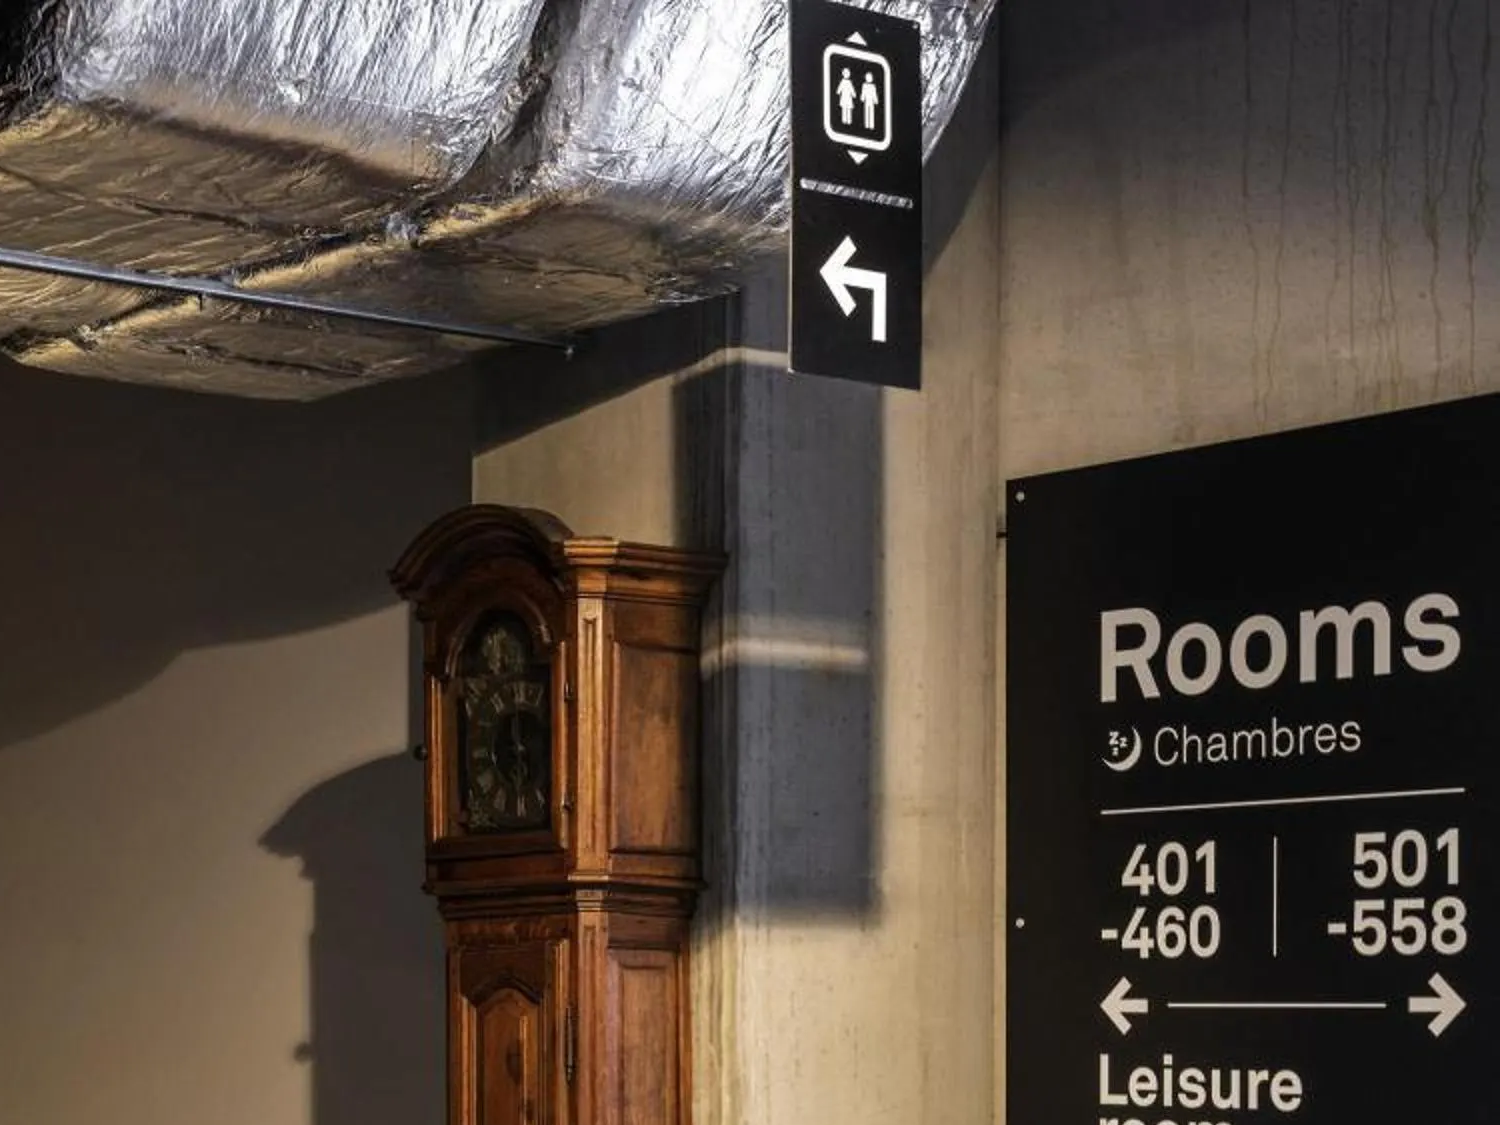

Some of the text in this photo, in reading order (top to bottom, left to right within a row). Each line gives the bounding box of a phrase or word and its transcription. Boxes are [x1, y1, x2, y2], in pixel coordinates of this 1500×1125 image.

[1100, 593, 1461, 703] Rooms
[1154, 717, 1361, 766] Chambres
[1121, 840, 1217, 896] 401
[1353, 827, 1459, 889] 501
[1101, 905, 1221, 959] -460
[1327, 896, 1467, 956] -558
[1099, 1053, 1303, 1112] Leisure
